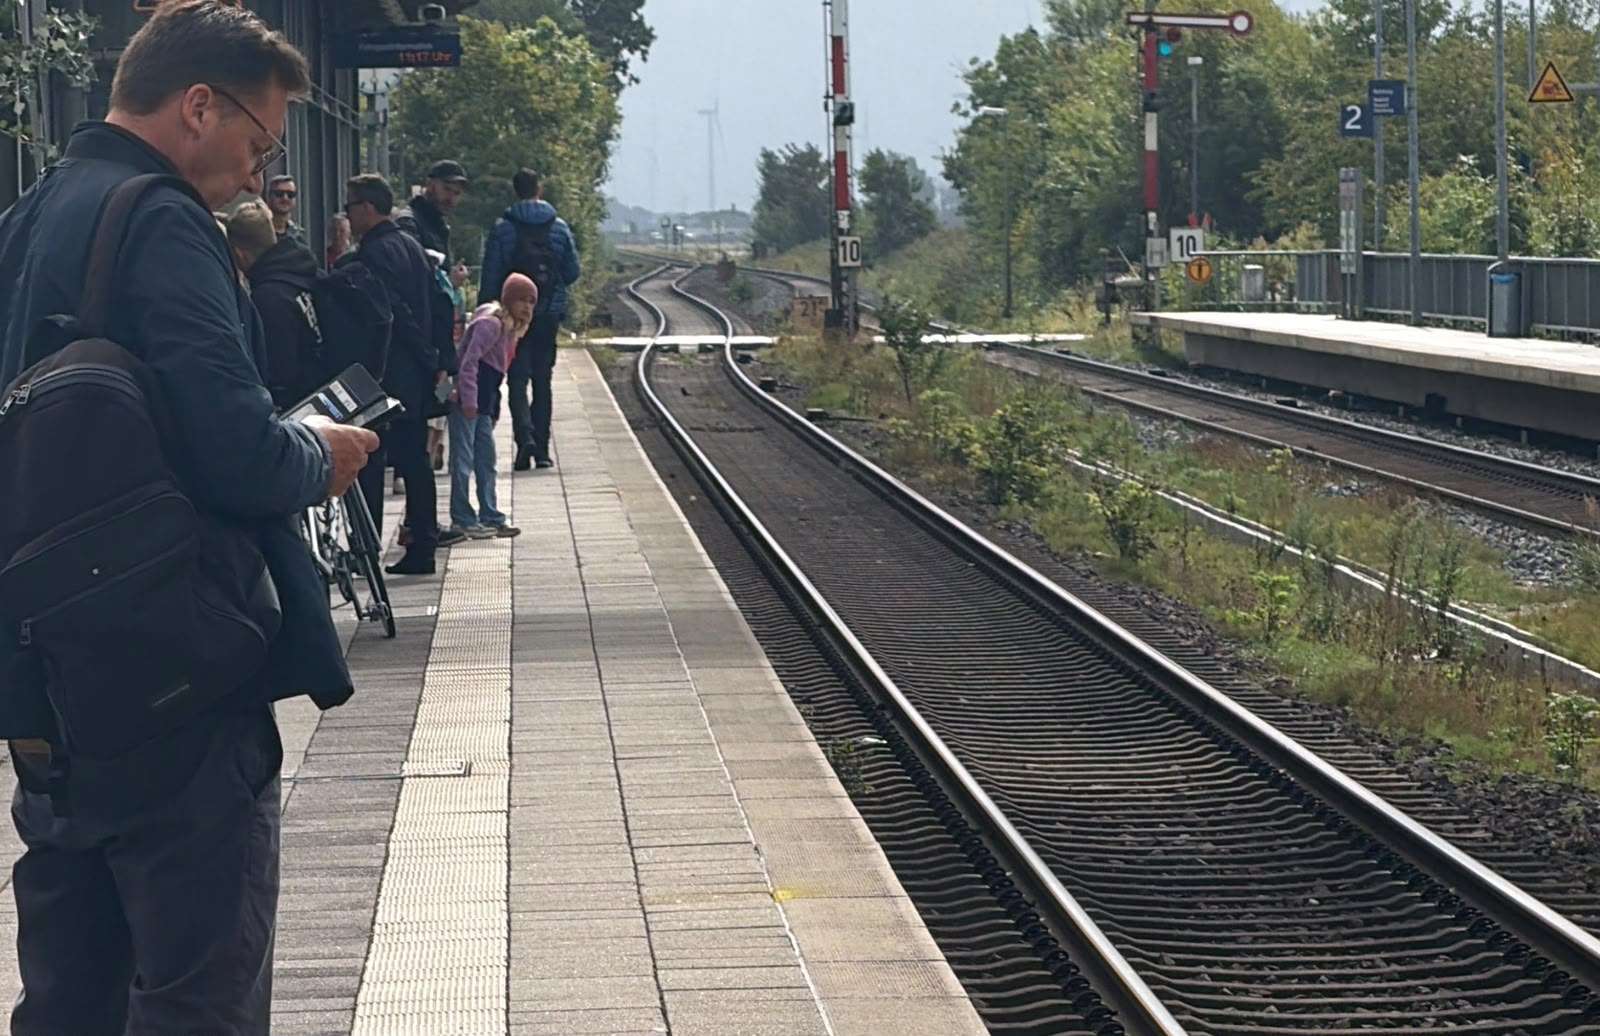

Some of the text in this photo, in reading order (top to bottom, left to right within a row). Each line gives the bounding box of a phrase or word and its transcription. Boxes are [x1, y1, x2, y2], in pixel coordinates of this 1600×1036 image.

[1345, 105, 1362, 130] 2
[840, 240, 860, 263] 10
[1176, 235, 1197, 258] 10
